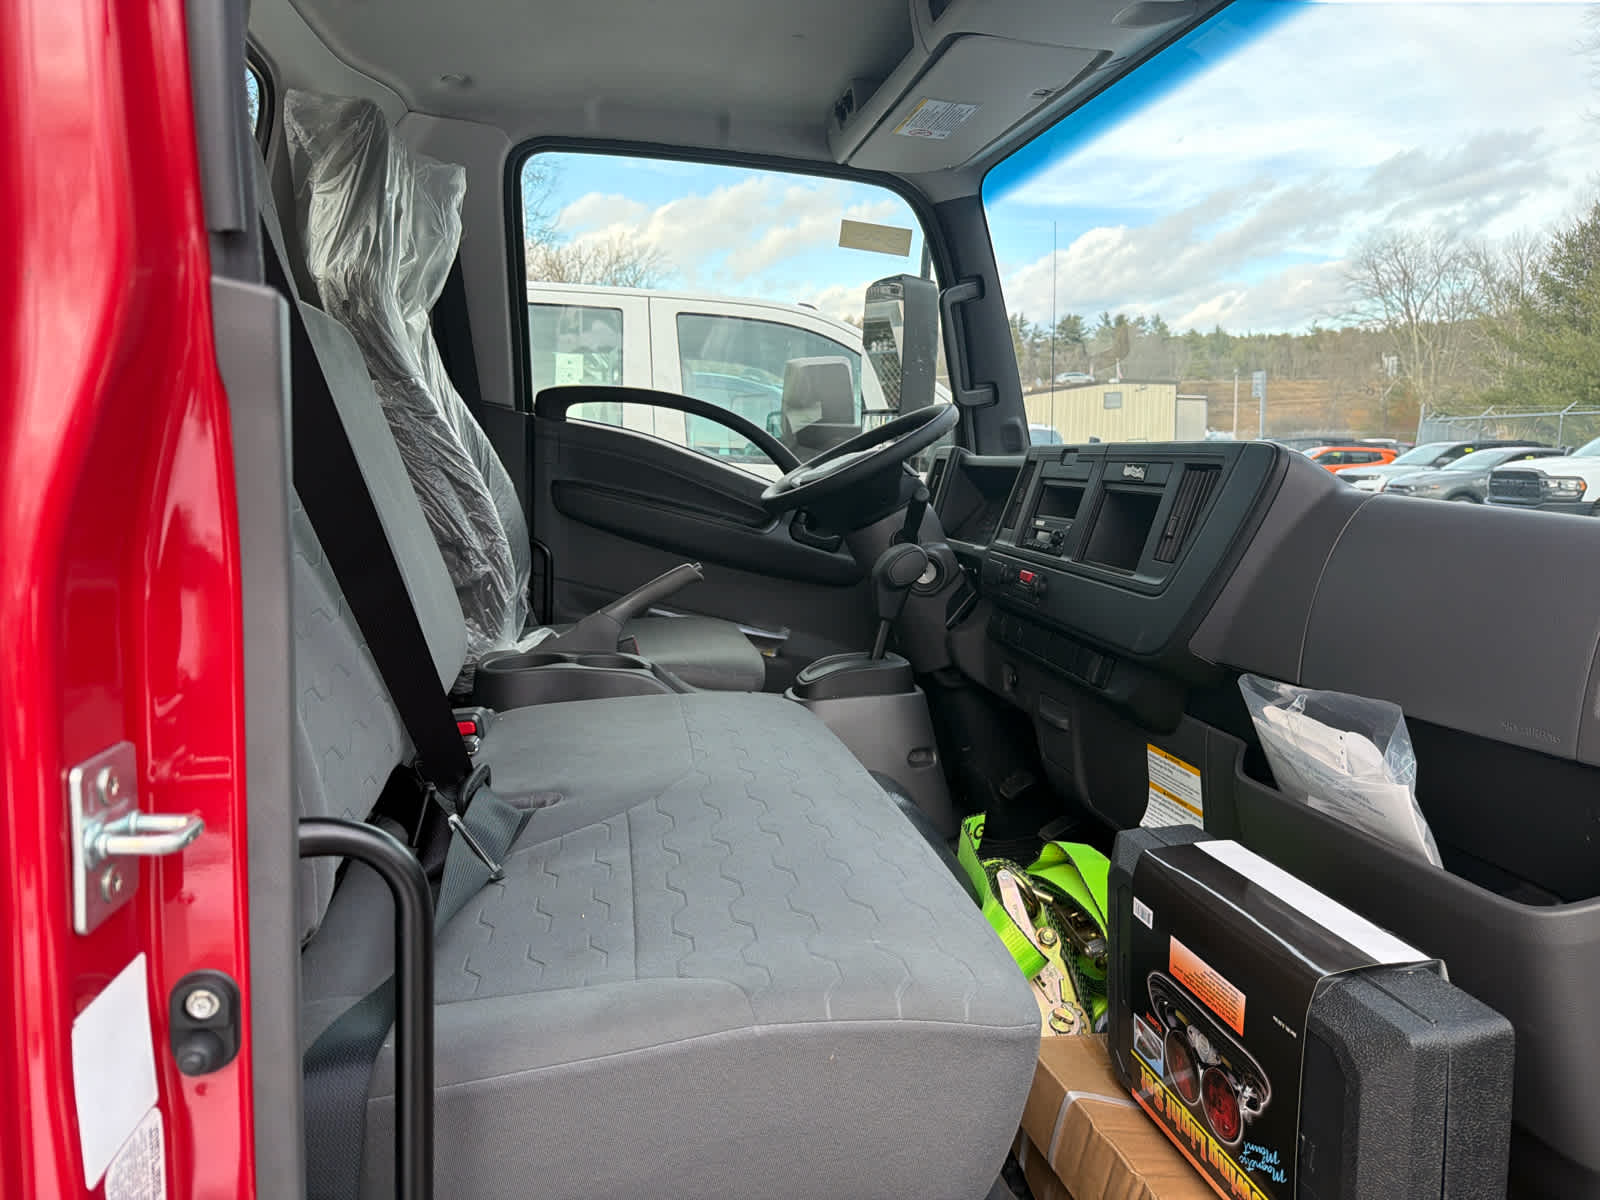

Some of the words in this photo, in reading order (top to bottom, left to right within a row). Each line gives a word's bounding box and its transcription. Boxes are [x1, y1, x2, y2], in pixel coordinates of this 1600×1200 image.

[1140, 1066, 1164, 1112] Set
[1166, 1094, 1207, 1162] Light
[1239, 1155, 1287, 1184] Magnetic
[1243, 1141, 1280, 1164] Mount
